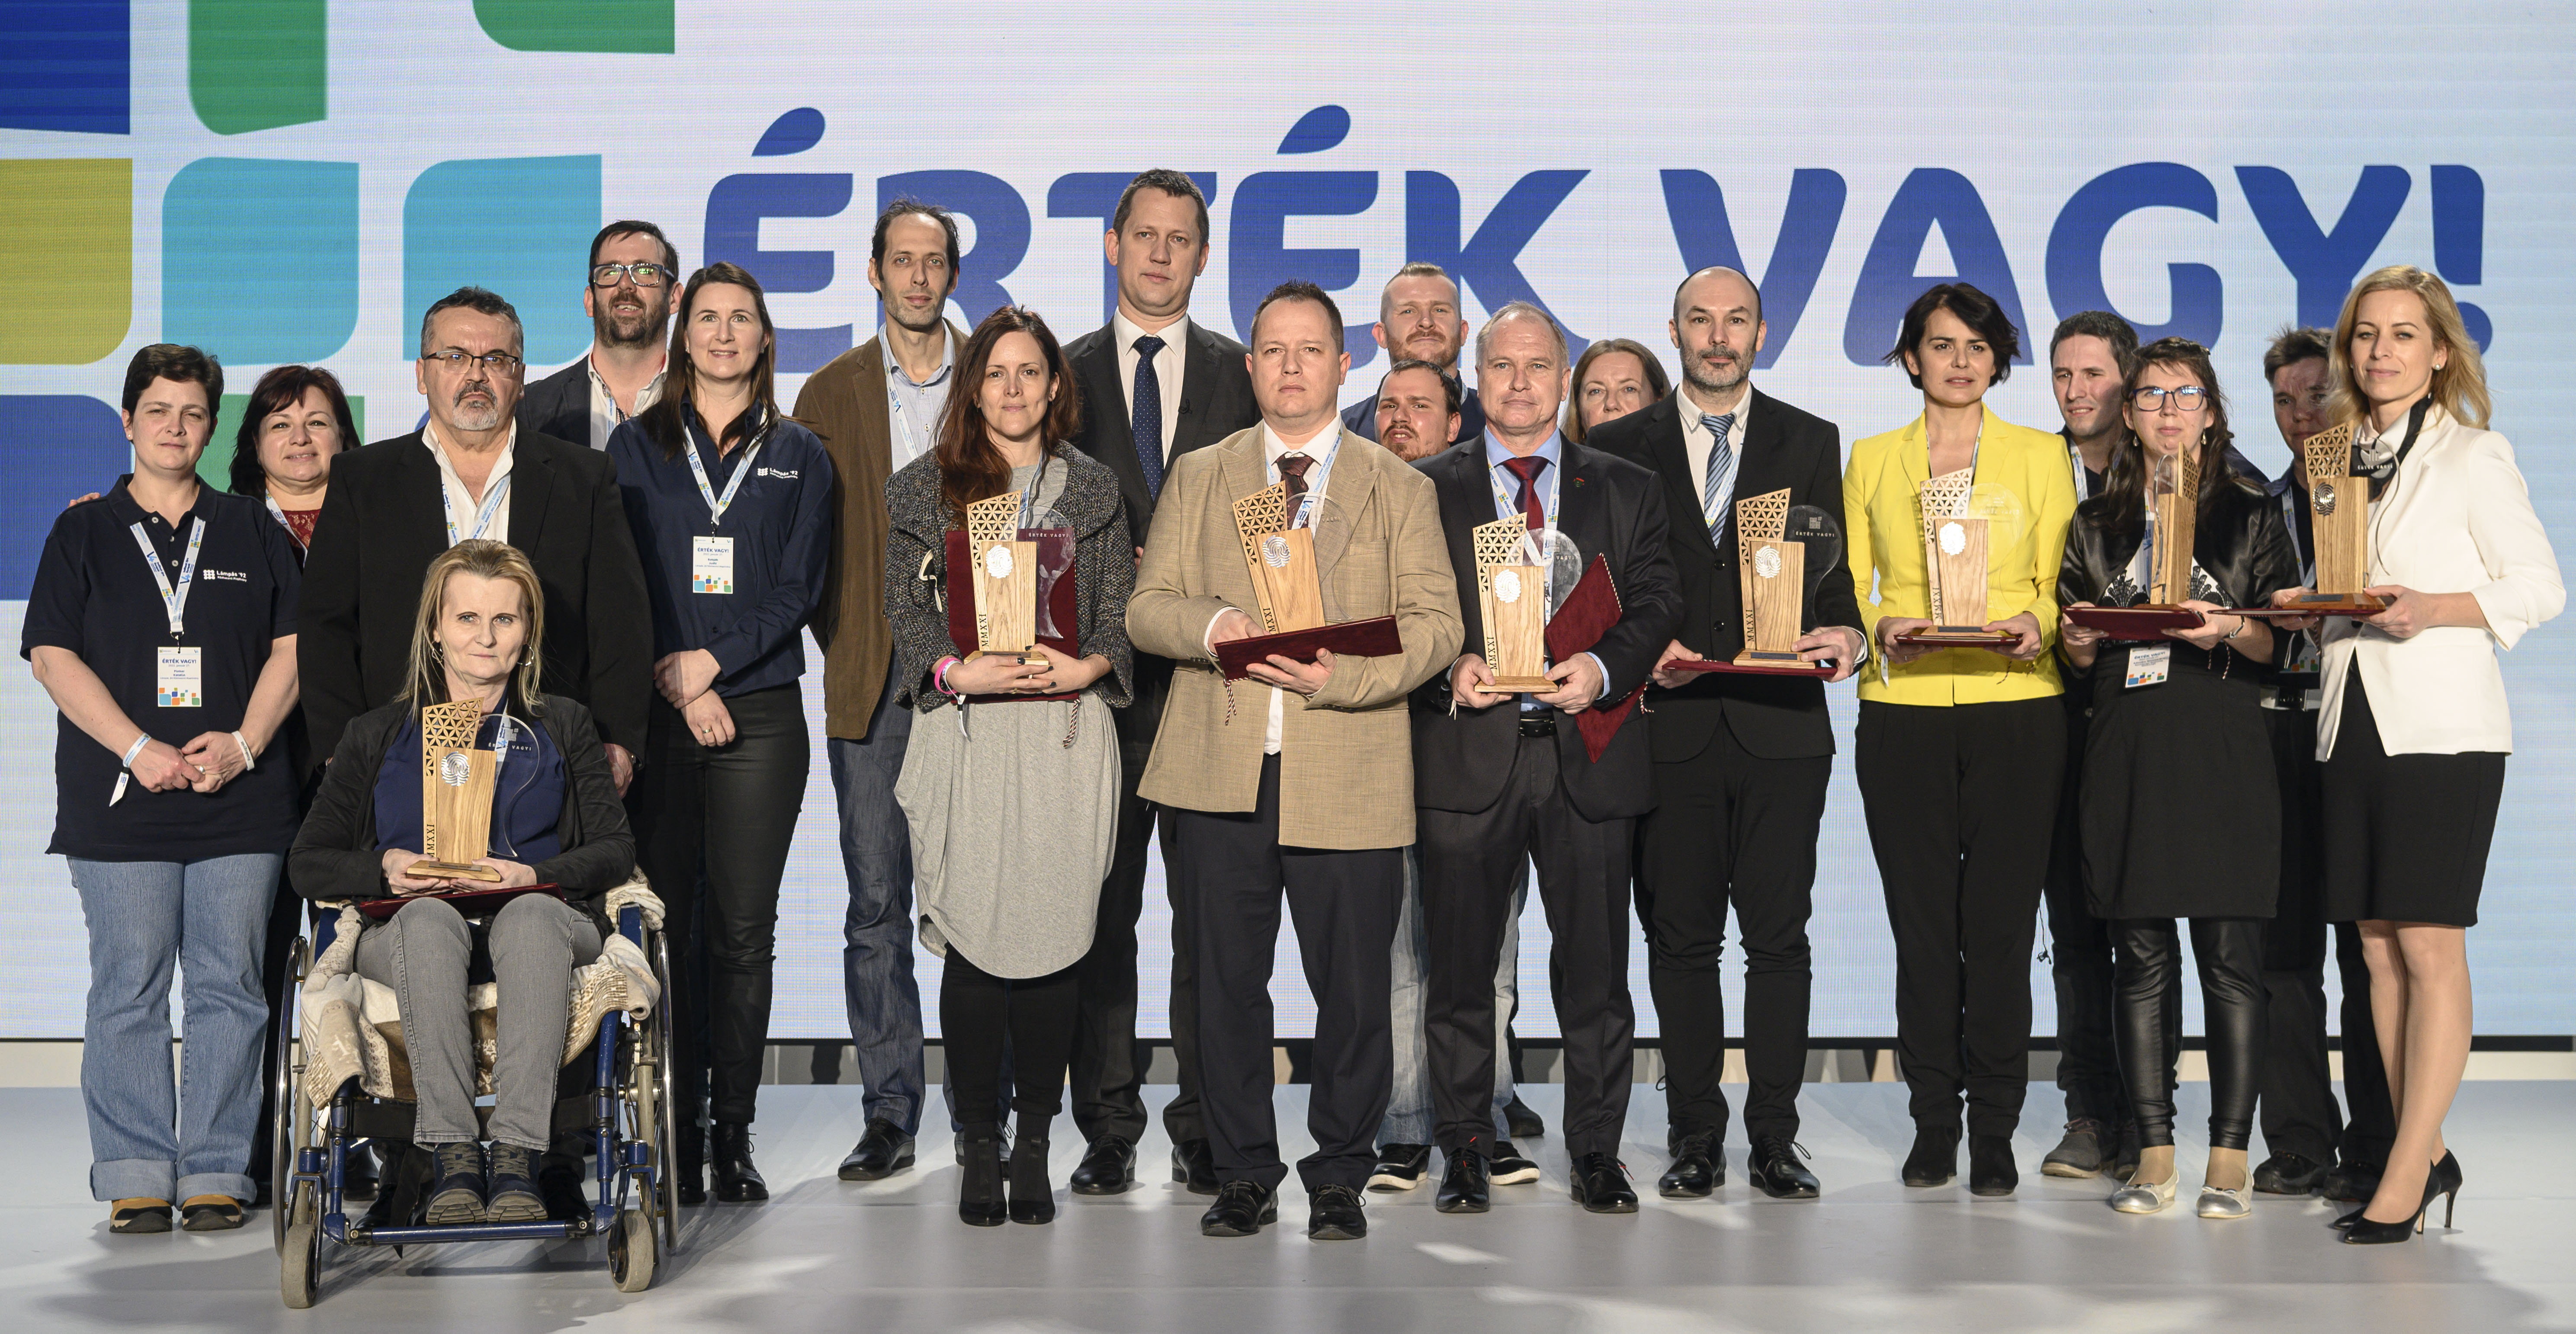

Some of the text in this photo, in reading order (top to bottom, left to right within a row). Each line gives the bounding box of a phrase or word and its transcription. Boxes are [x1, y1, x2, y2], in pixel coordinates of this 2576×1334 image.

[1660, 162, 2492, 369] VAGY!
[1263, 607, 1276, 632] MXXI
[1932, 587, 1941, 619] MMXXI
[979, 614, 989, 647] MMXXI
[1746, 609, 1755, 642] MMXXI
[1487, 637, 1497, 670] MMXXI
